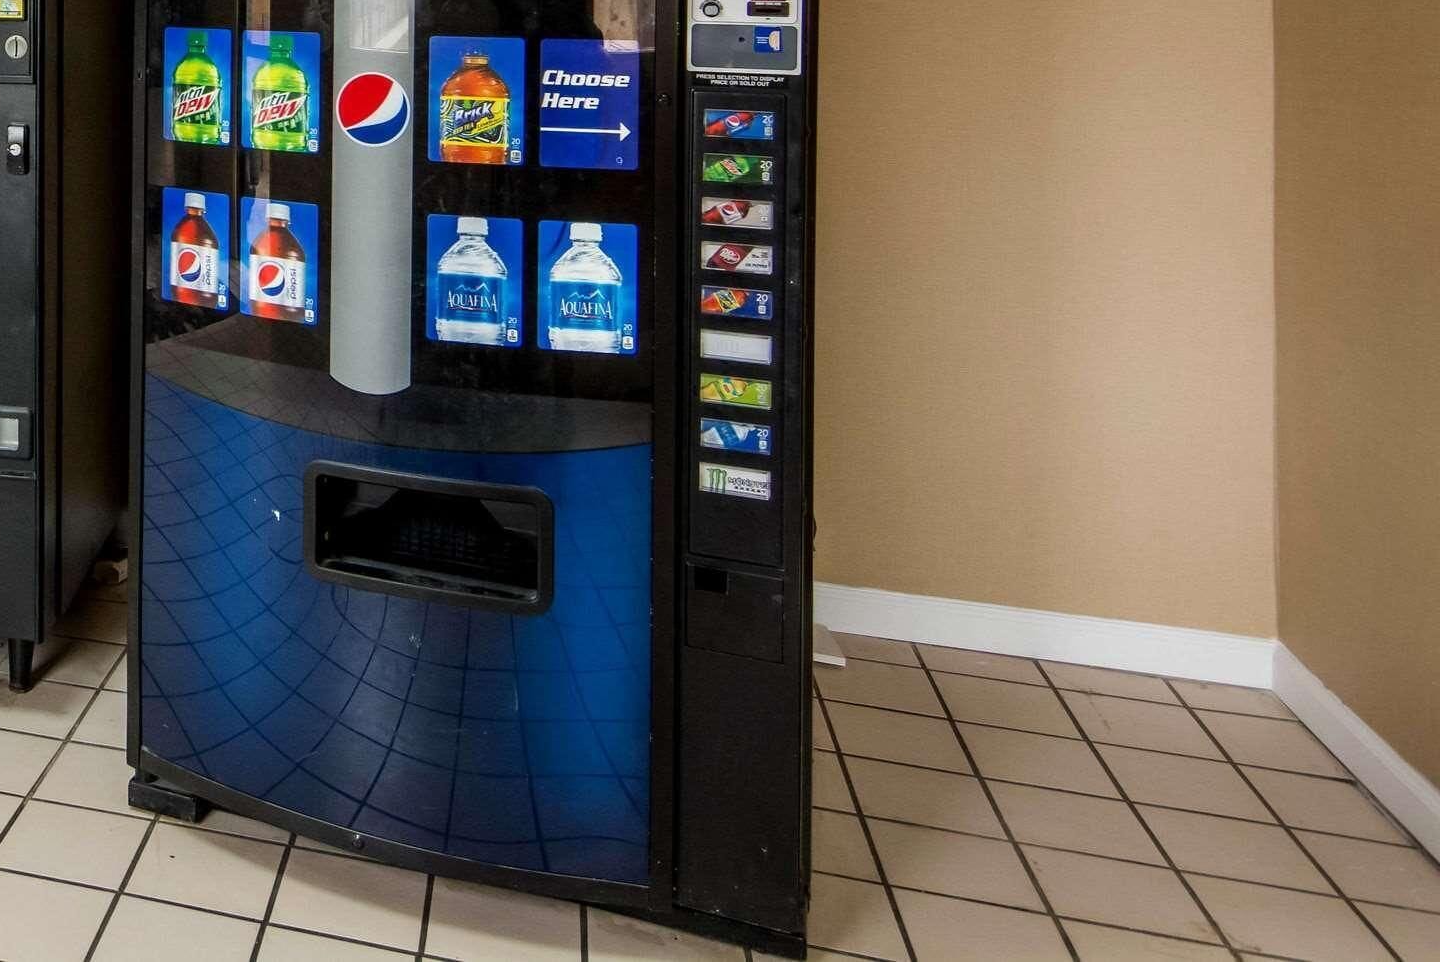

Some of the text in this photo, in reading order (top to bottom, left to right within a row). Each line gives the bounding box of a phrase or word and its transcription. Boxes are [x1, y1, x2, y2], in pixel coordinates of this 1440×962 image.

[542, 69, 632, 88] Choose
[541, 93, 600, 110] Here
[447, 290, 498, 313] AQUAFINA
[756, 293, 769, 302] 20
[560, 297, 612, 320] AQUAFINA
[757, 428, 768, 438] 20
